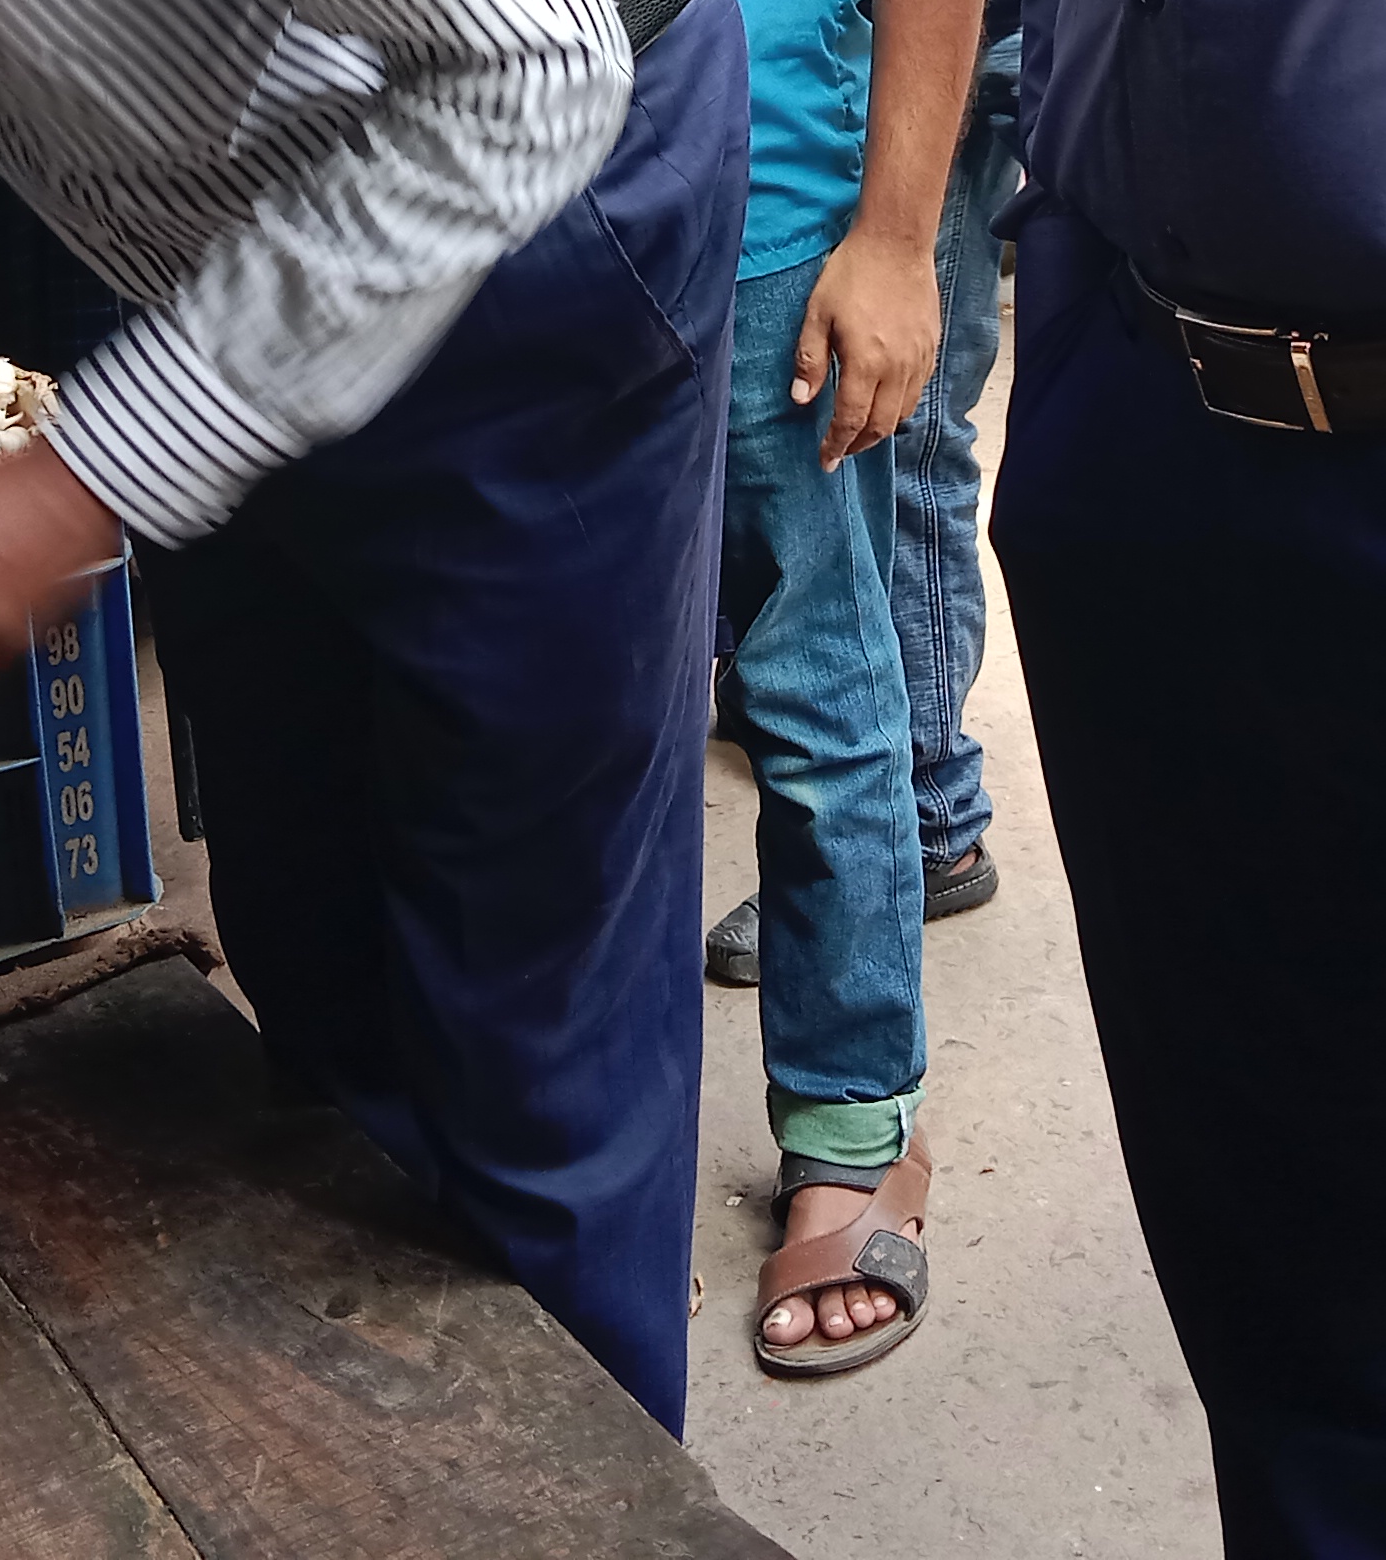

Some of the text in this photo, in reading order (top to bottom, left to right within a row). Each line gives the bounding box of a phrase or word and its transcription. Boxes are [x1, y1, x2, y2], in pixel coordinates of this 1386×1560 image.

[45, 622, 80, 666] 98
[50, 674, 85, 720] 90
[57, 726, 91, 772] 54
[61, 781, 94, 826] 06
[65, 834, 99, 880] 73
